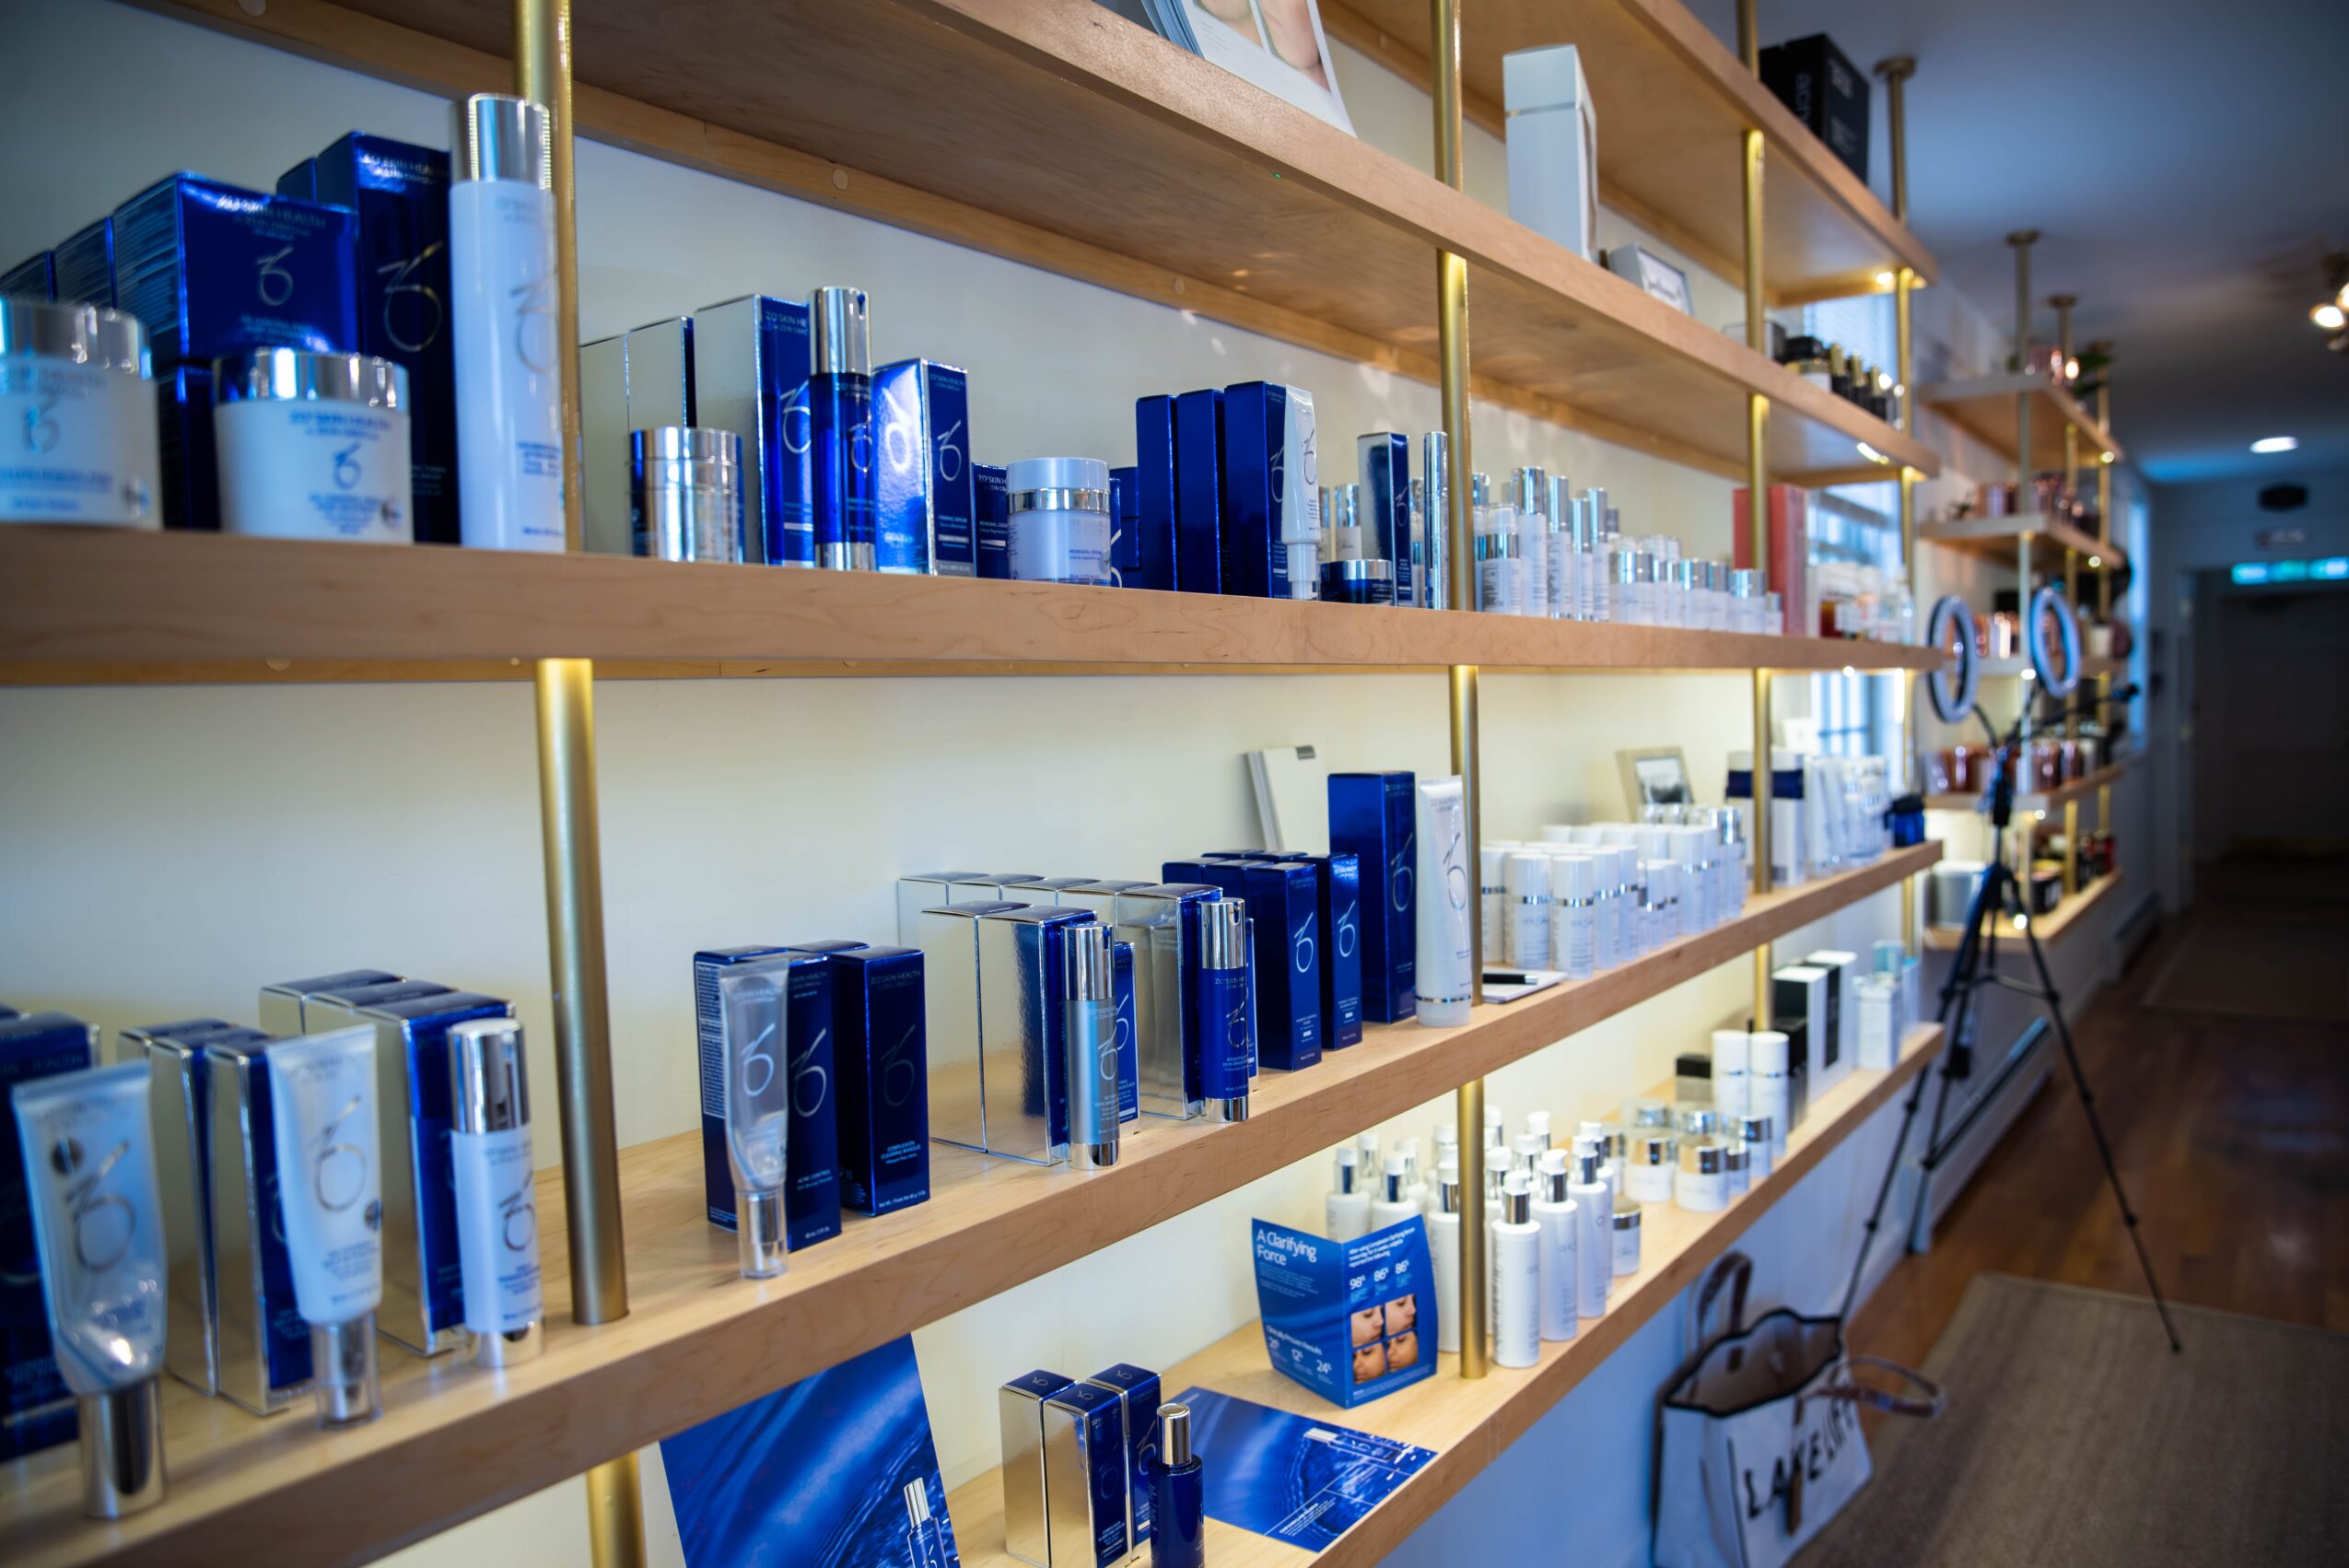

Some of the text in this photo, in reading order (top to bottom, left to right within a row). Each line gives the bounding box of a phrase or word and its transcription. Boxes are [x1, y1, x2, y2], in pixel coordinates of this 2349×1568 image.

[1256, 1228, 1317, 1263] A Clarifying
[1257, 1244, 1287, 1266] Force
